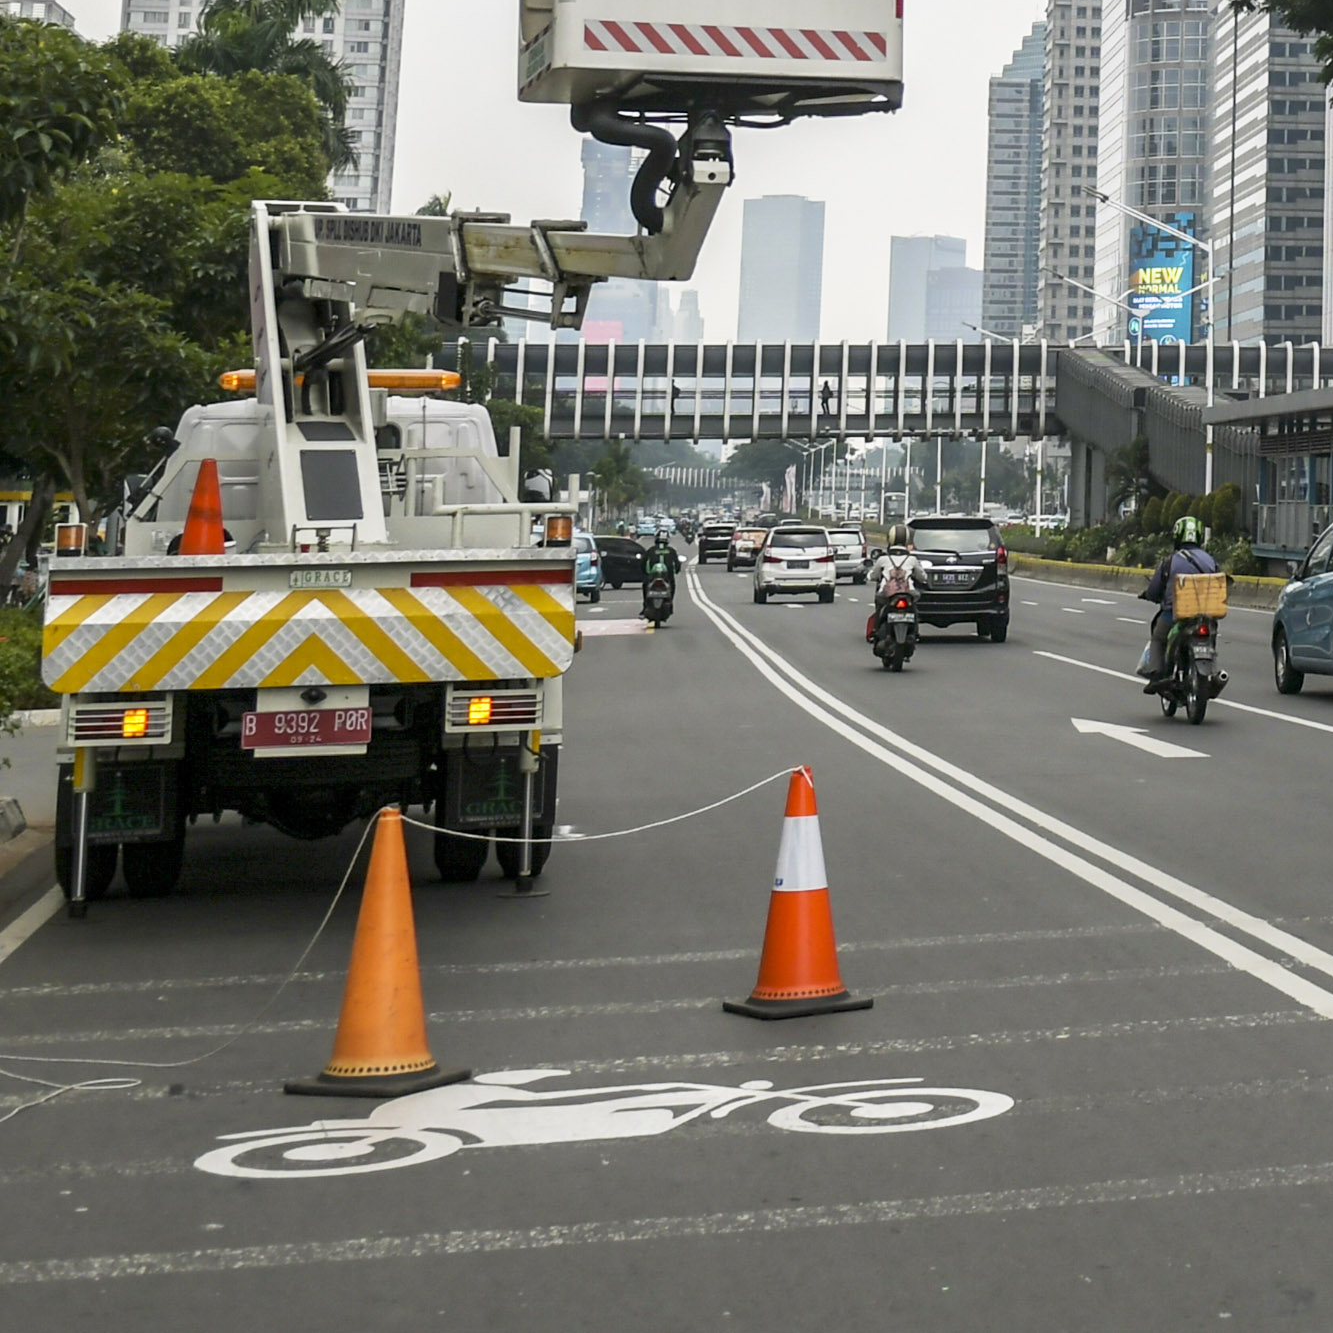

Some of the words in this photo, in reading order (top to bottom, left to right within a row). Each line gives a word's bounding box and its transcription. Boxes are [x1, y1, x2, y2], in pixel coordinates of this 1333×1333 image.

[386, 221, 422, 247] JAKARTA
[1138, 267, 1183, 284] NEW
[304, 571, 349, 584] GRACE
[245, 715, 257, 736] B
[274, 712, 320, 734] 9392
